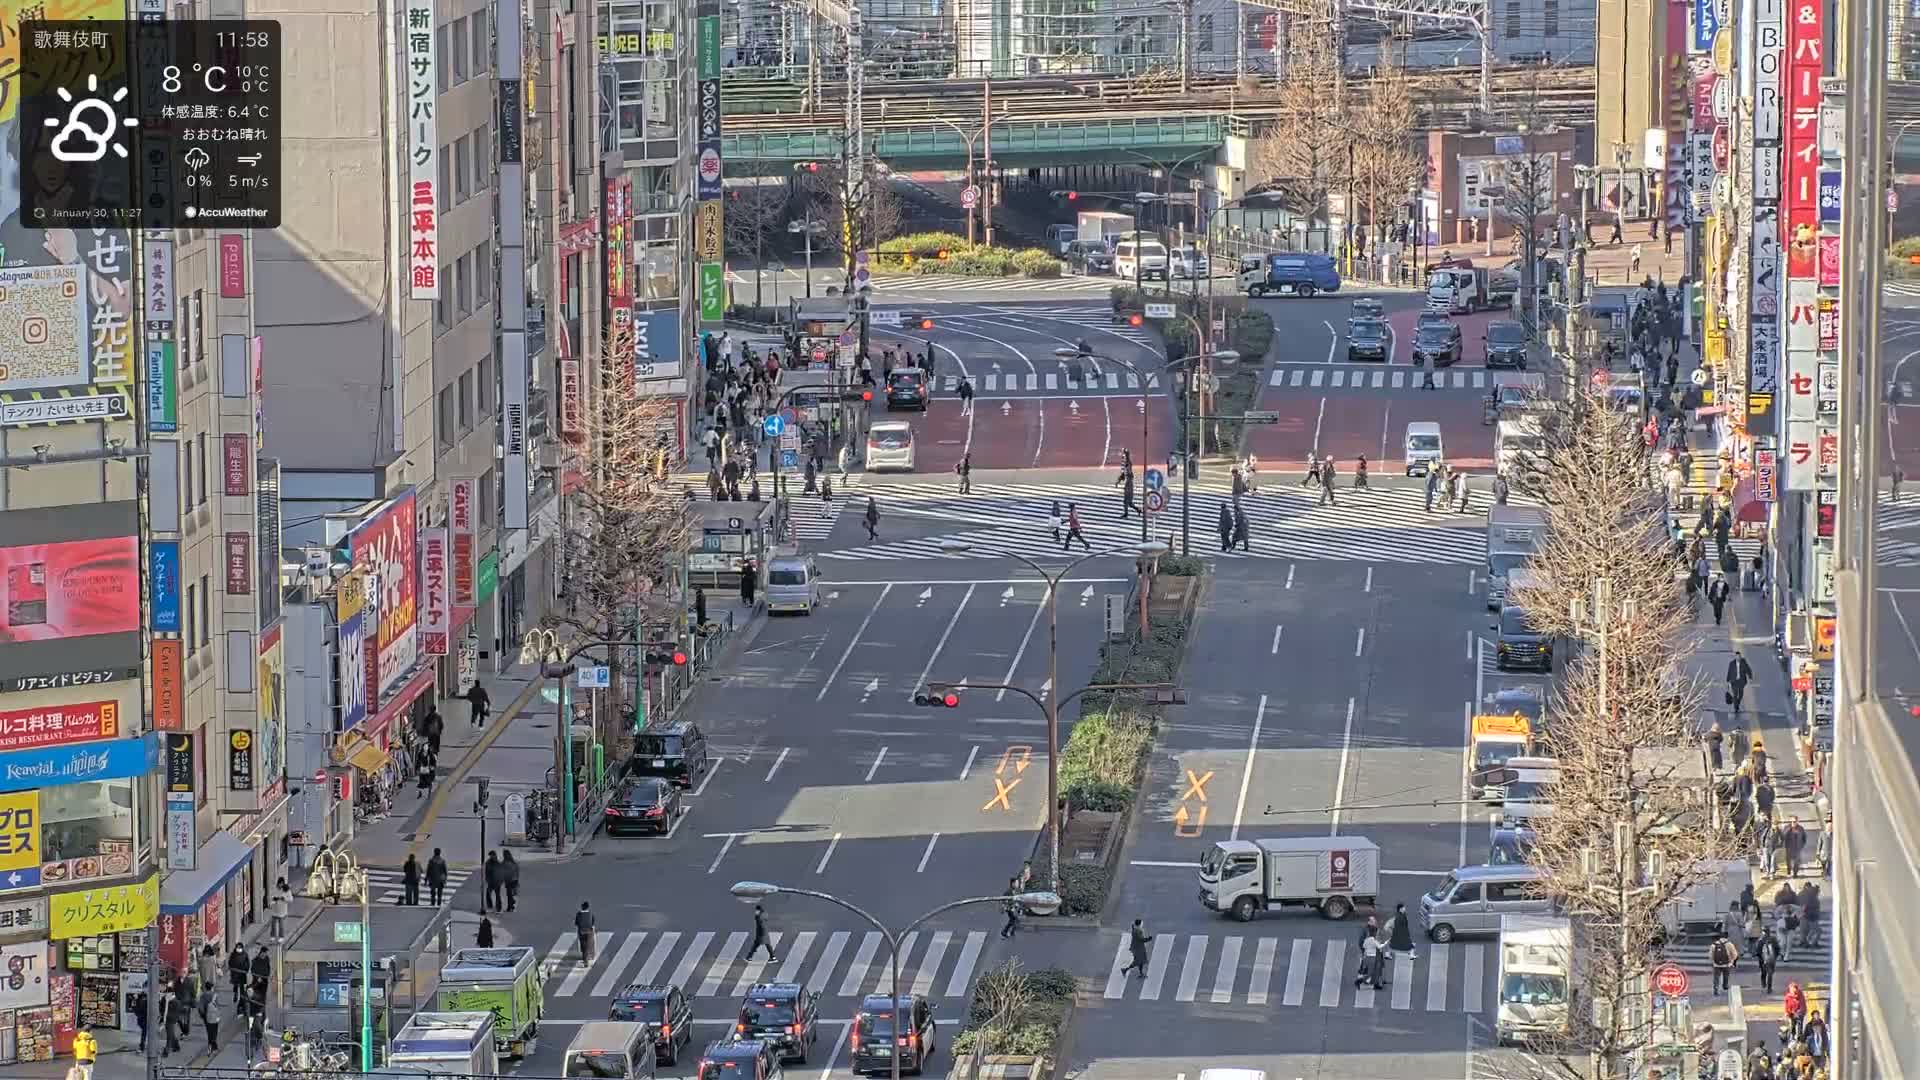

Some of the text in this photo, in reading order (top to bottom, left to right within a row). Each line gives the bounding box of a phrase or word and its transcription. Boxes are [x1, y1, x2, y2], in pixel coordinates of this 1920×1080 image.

[408, 8, 433, 167] 新宿サンパーク
[412, 181, 436, 289] 三平本館
[704, 271, 717, 310] レイク
[88, 229, 128, 384] せい先生
[151, 351, 162, 411] FamilyMart
[47, 402, 105, 415] たいせい先生
[427, 538, 443, 626] 三平ストア
[103, 708, 113, 732] 5F
[19, 731, 63, 744] RESTAURANT
[0, 807, 33, 829] プロ
[0, 832, 33, 854] ミス
[0, 908, 33, 928] 囲碁
[63, 900, 136, 923] クリスタル
[320, 987, 337, 1001] 12
